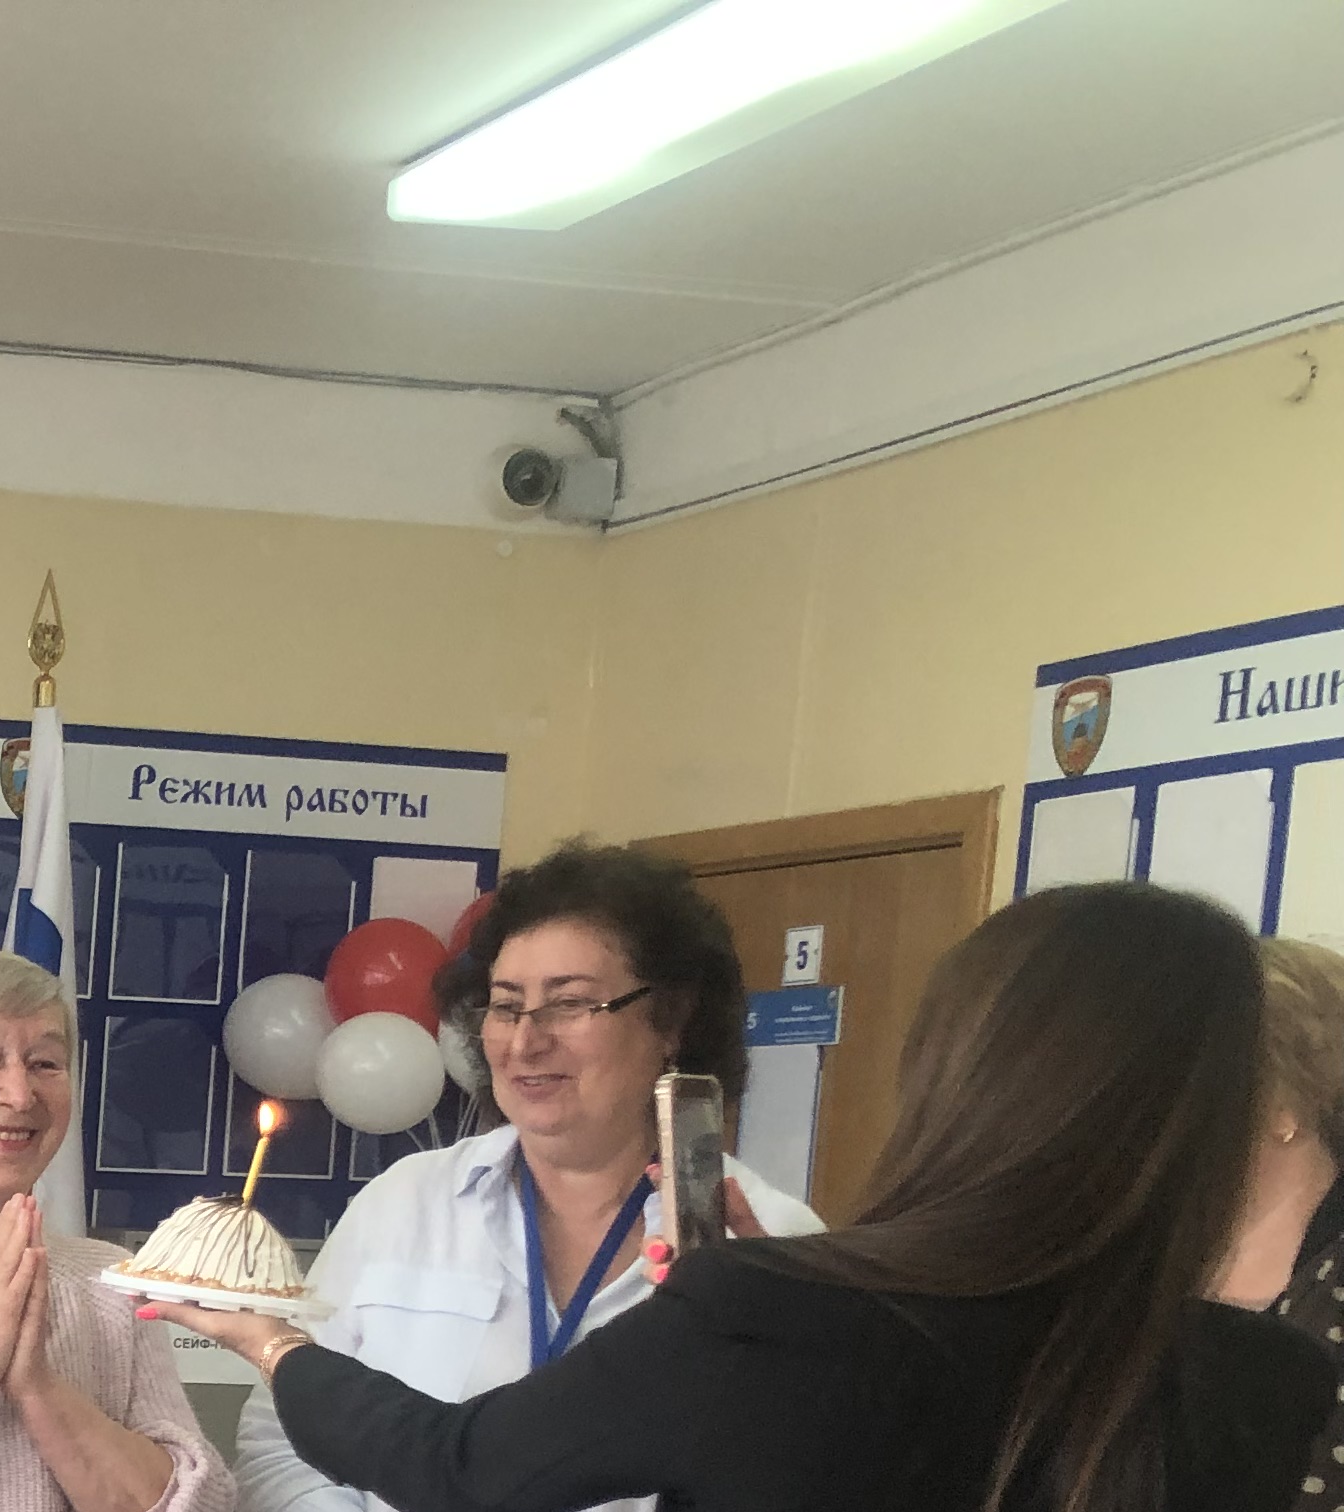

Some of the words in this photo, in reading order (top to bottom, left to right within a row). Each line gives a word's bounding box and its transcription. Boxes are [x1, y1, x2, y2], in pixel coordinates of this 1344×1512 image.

[128, 764, 267, 808] Режим
[285, 785, 428, 822] работы
[796, 941, 809, 970] 5
[747, 1012, 758, 1030] 5
